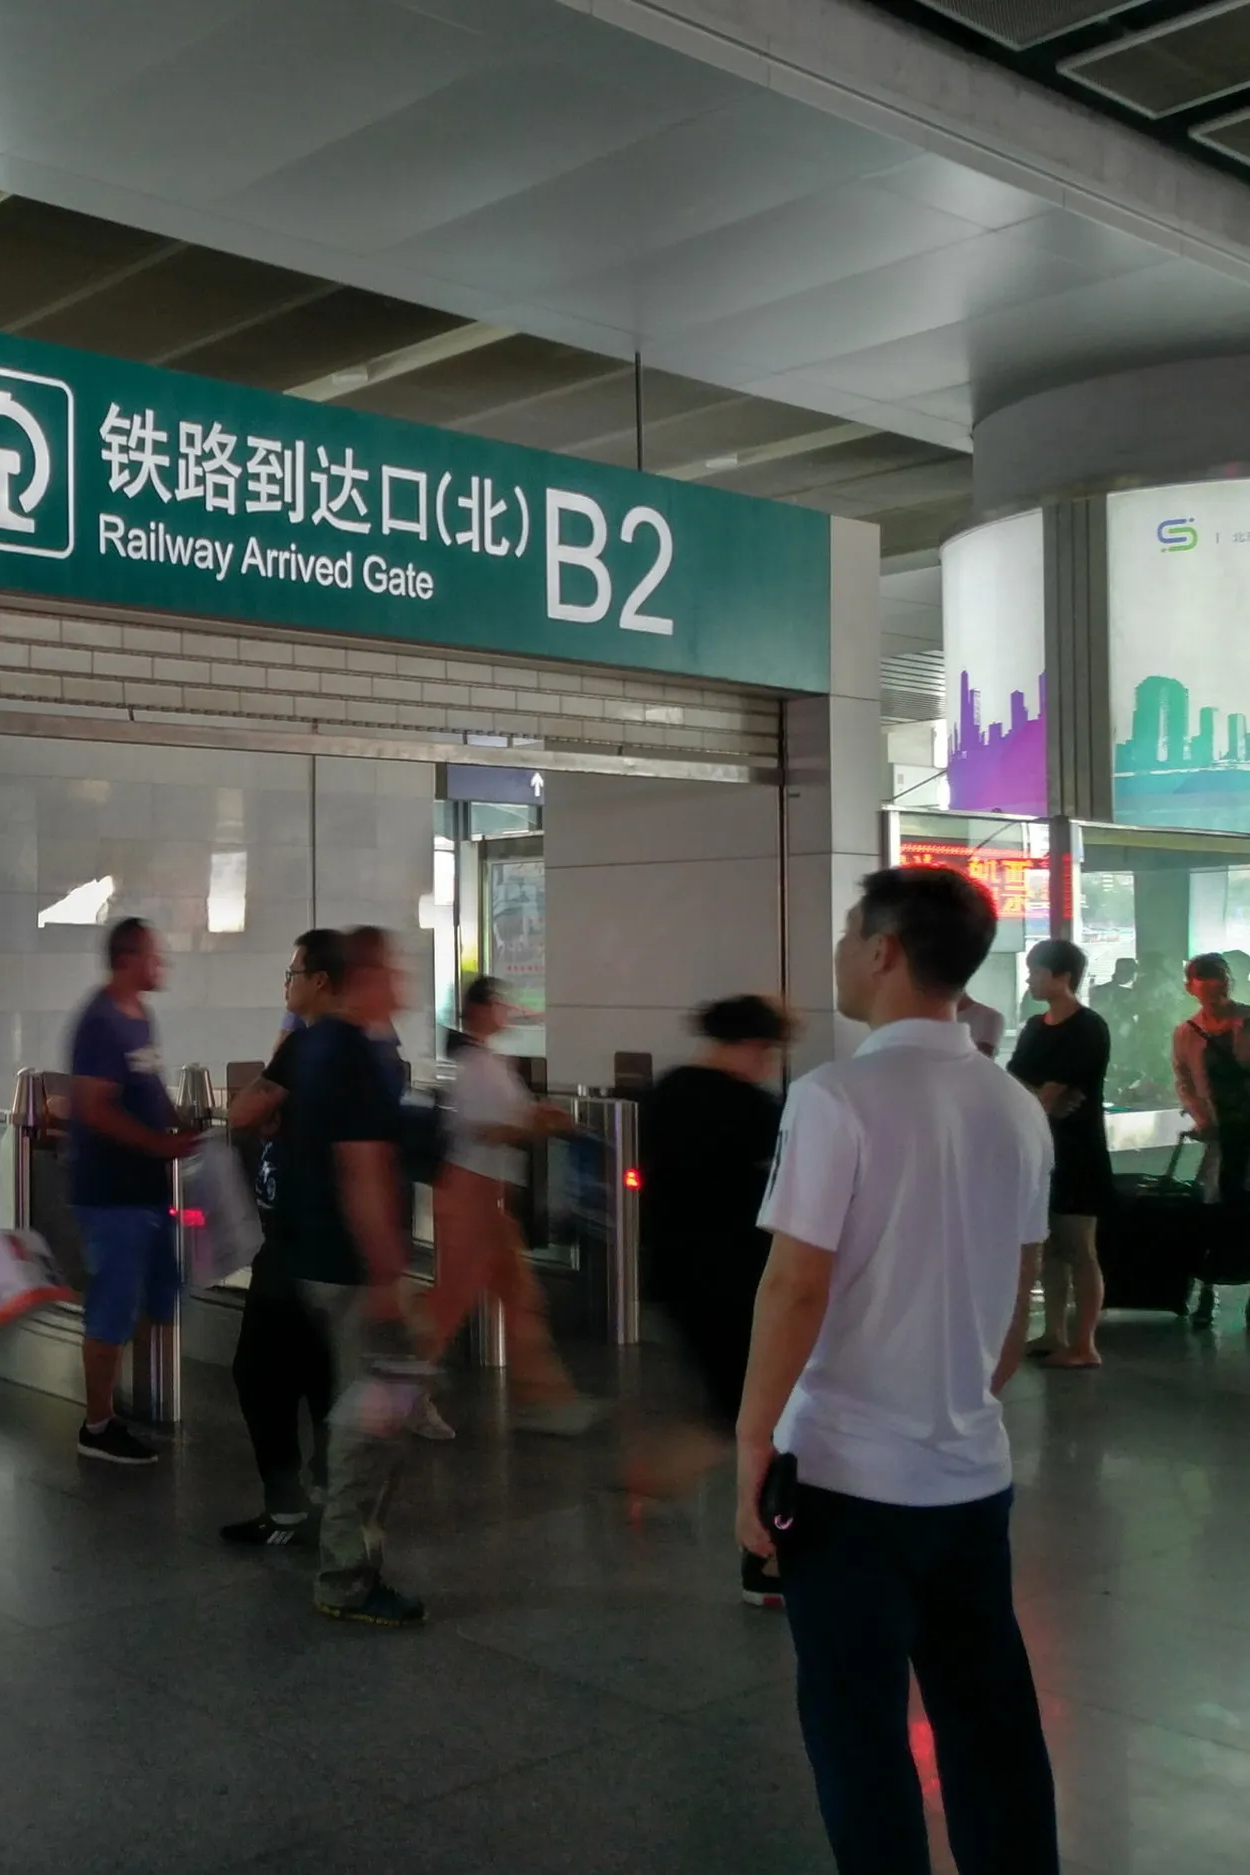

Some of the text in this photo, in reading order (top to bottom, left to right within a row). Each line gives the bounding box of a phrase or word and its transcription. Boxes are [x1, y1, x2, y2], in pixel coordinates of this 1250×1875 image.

[99, 402, 530, 558] 铁路到达口(北)
[99, 513, 434, 600] Railway Arrived Gate
[546, 487, 674, 635] B2
